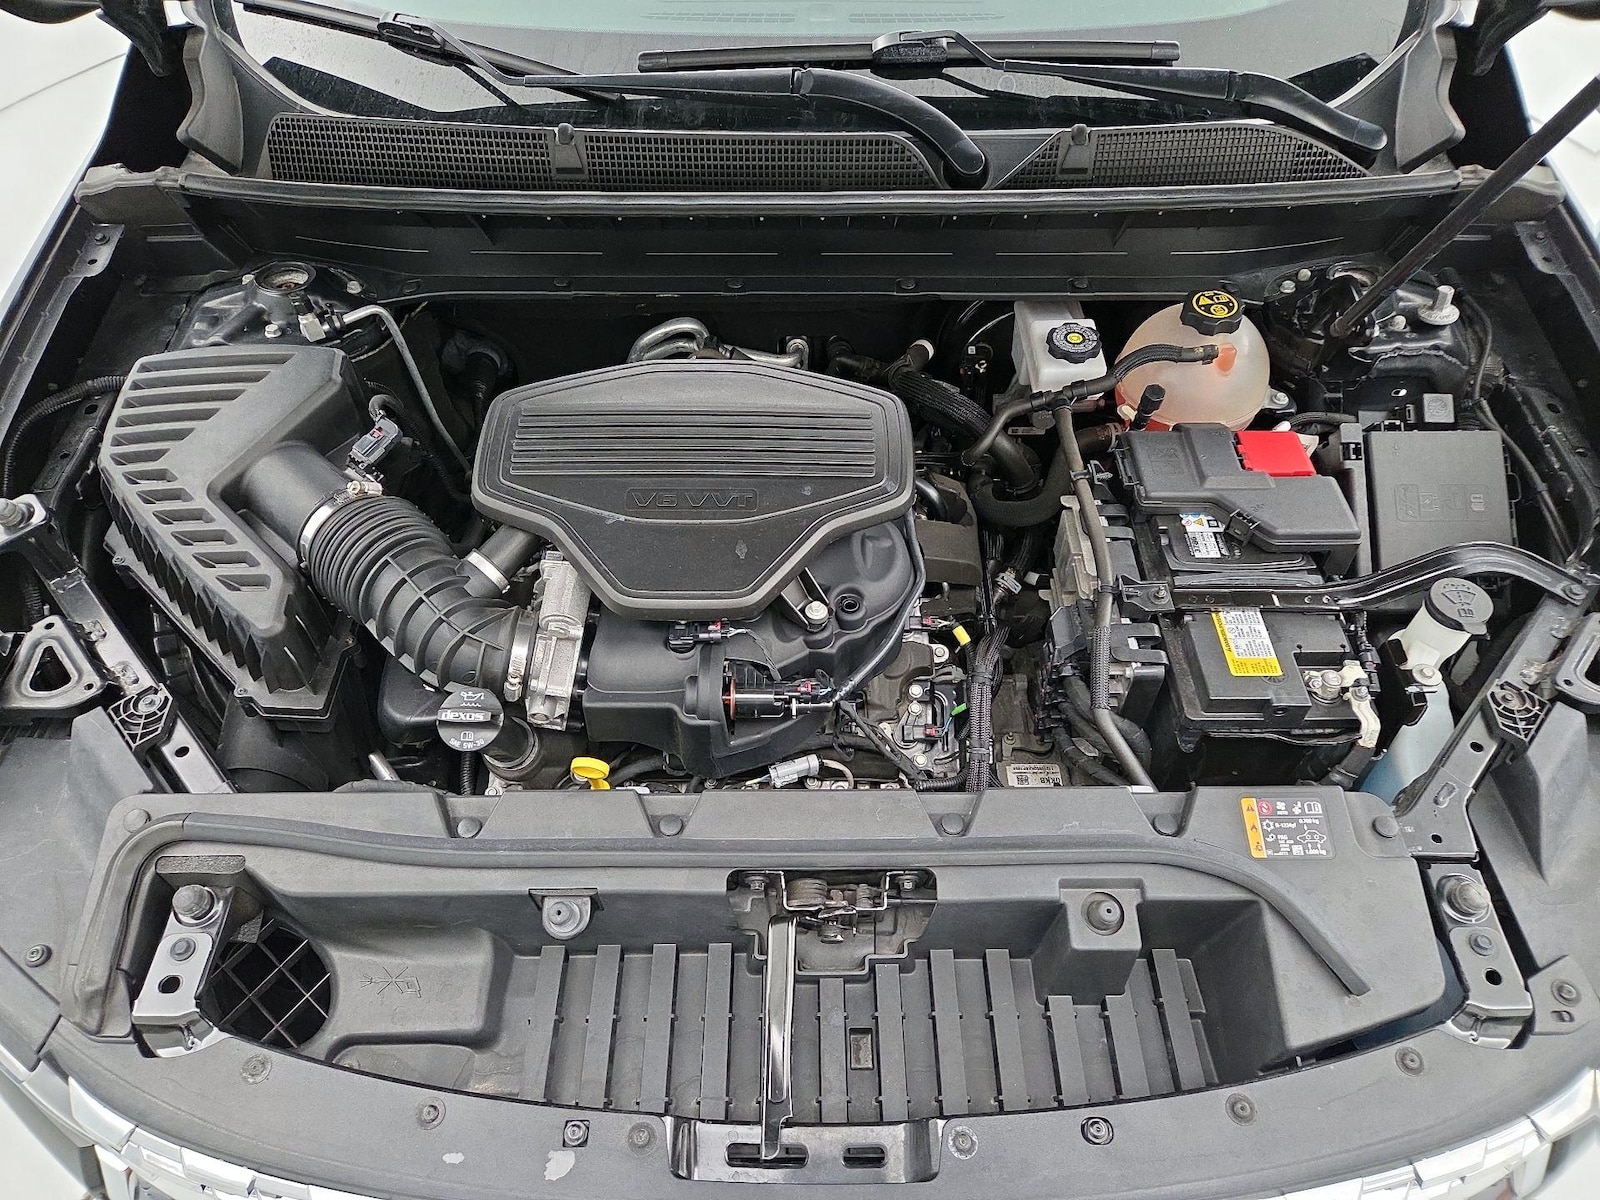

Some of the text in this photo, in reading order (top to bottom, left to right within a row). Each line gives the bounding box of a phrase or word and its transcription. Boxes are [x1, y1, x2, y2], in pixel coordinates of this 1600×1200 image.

[631, 492, 753, 507] V6 VVT
[441, 709, 485, 721] dexos
[449, 737, 485, 749] SAE 5W-30
